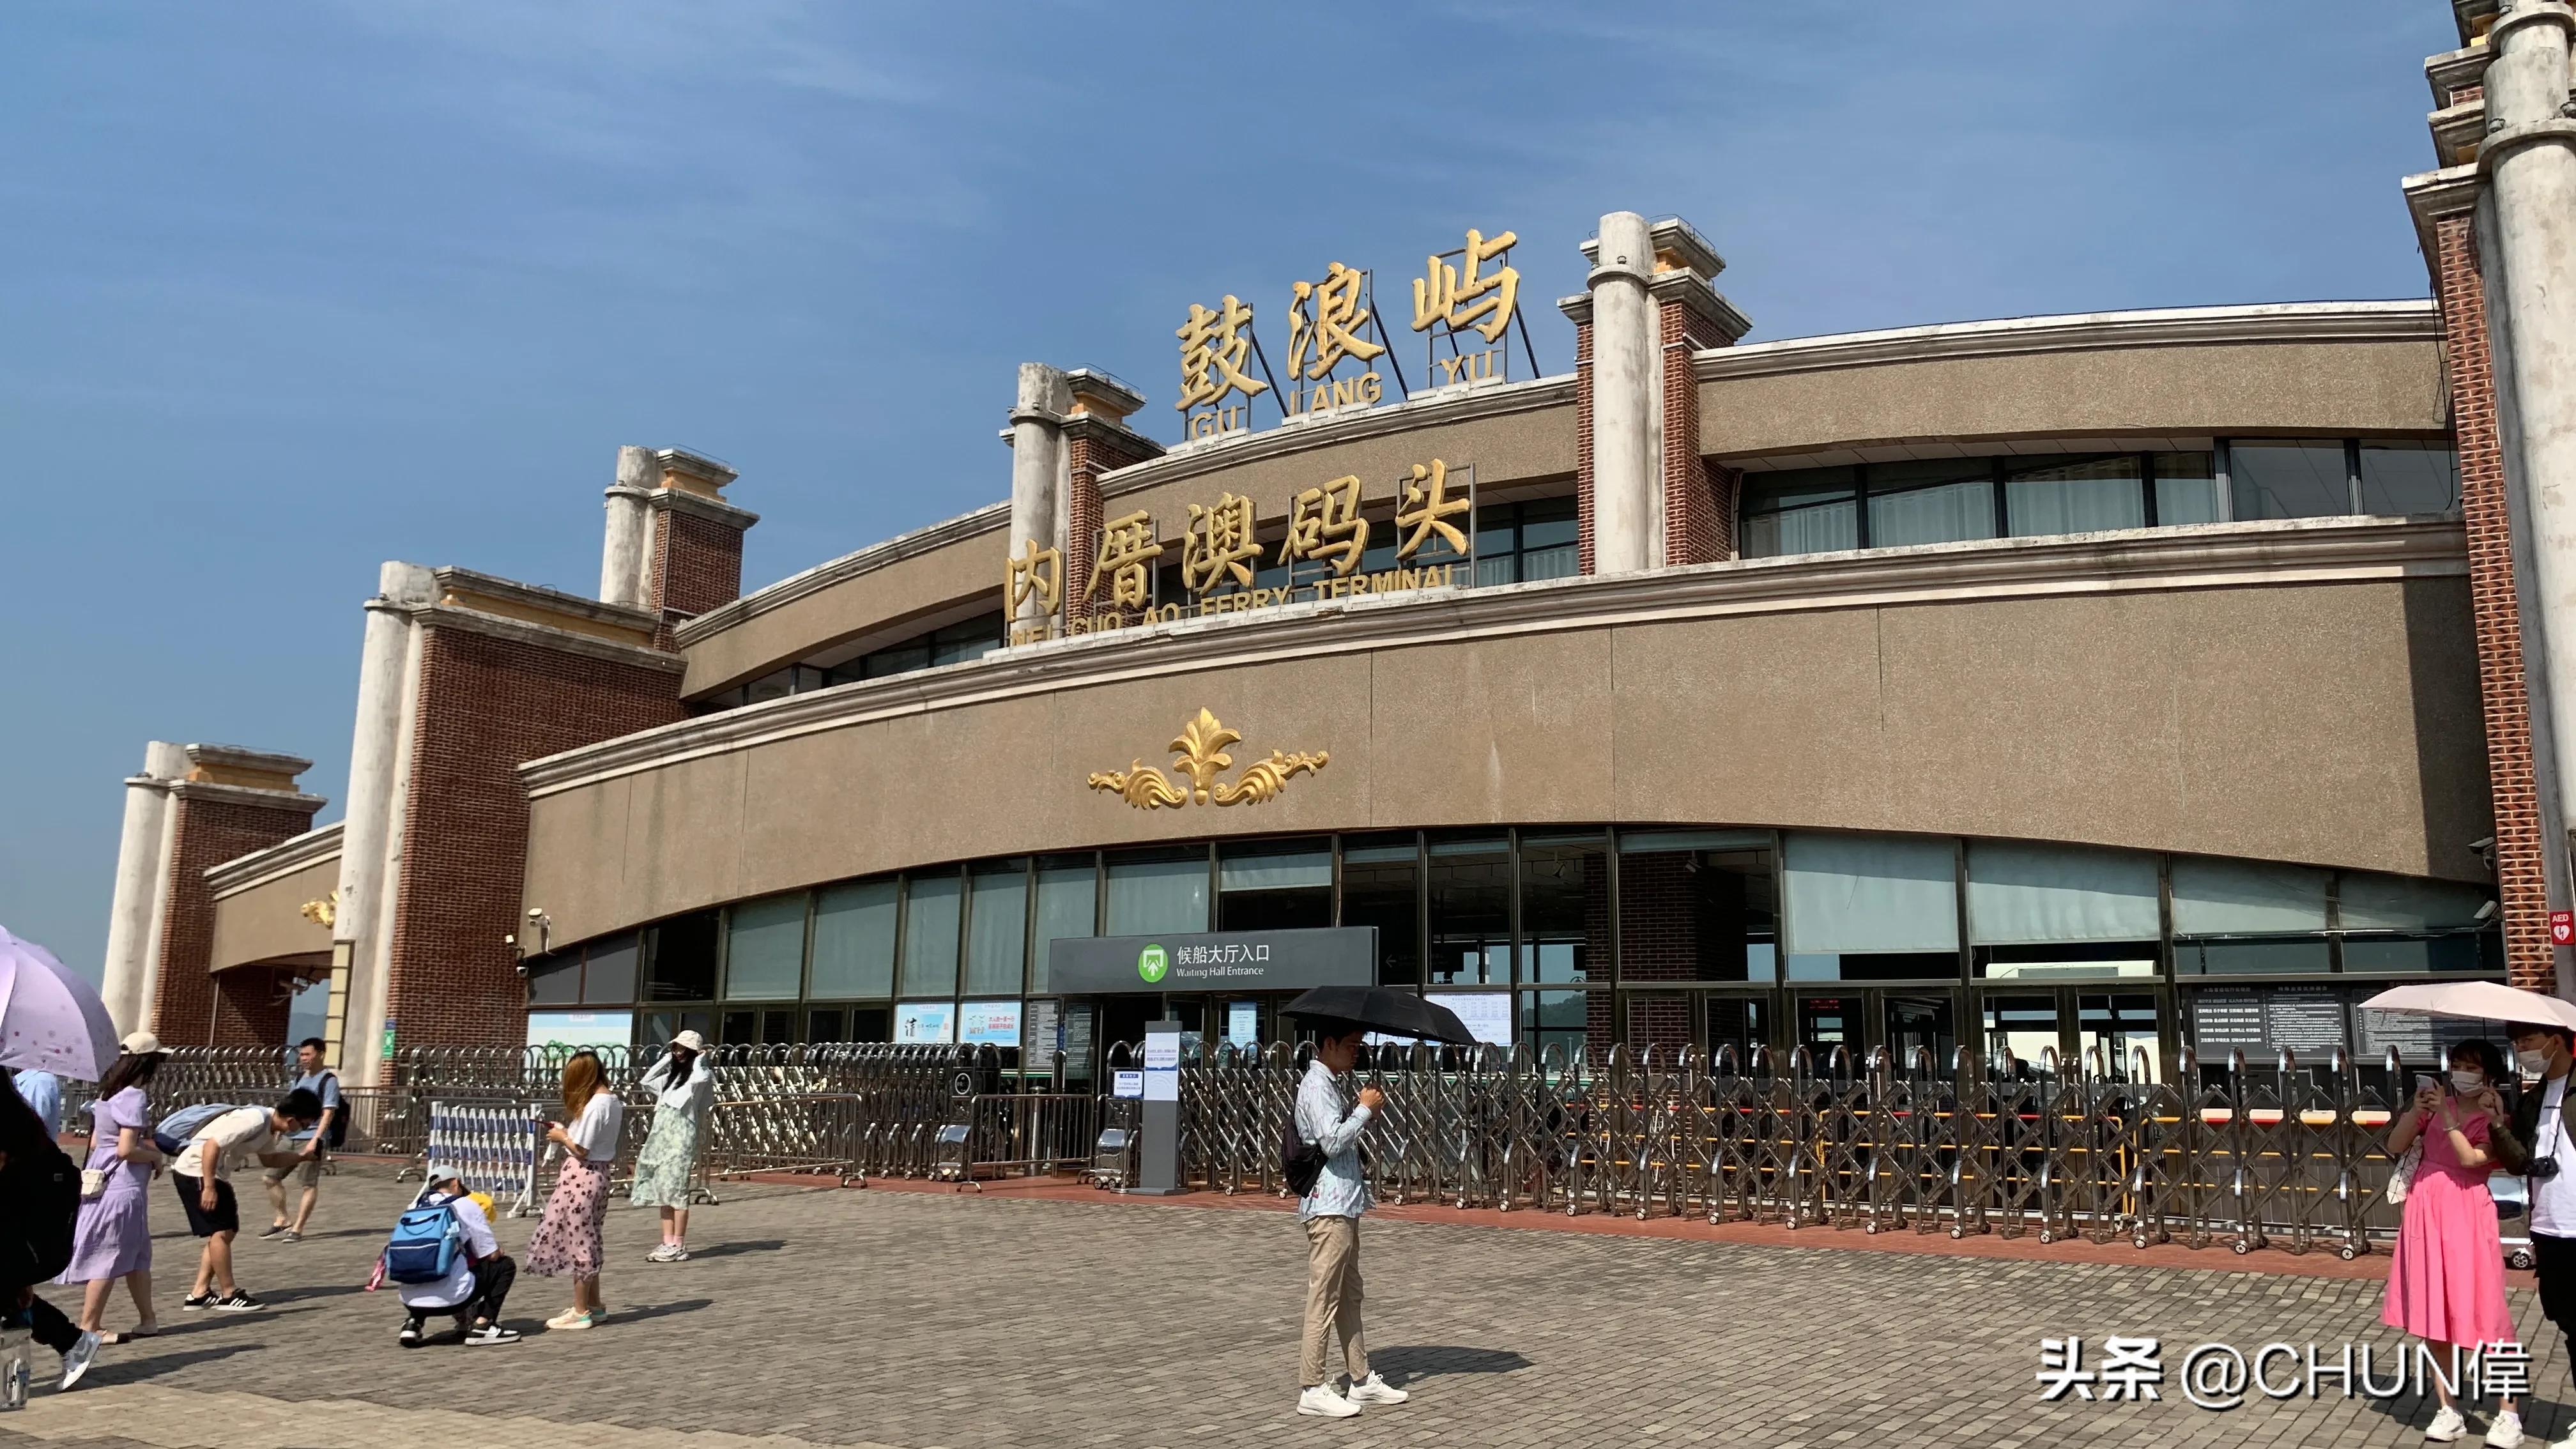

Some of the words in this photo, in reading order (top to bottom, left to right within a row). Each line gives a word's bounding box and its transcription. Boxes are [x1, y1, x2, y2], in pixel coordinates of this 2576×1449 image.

[1176, 228, 1520, 411] 鼓浪屿
[1191, 405, 1238, 440] GU
[1441, 349, 1493, 385] YU
[1004, 458, 1471, 622] 内厝澳码头
[1142, 602, 1181, 625] AO
[1200, 585, 1291, 616] FERRY
[1313, 564, 1453, 599] TERMINAL
[2552, 914, 2569, 923] AED
[1176, 968, 1208, 979] Waiting
[1209, 966, 1225, 976] Hall
[1227, 966, 1264, 976] Entrance
[1177, 944, 1269, 965] 候船大厅入口
